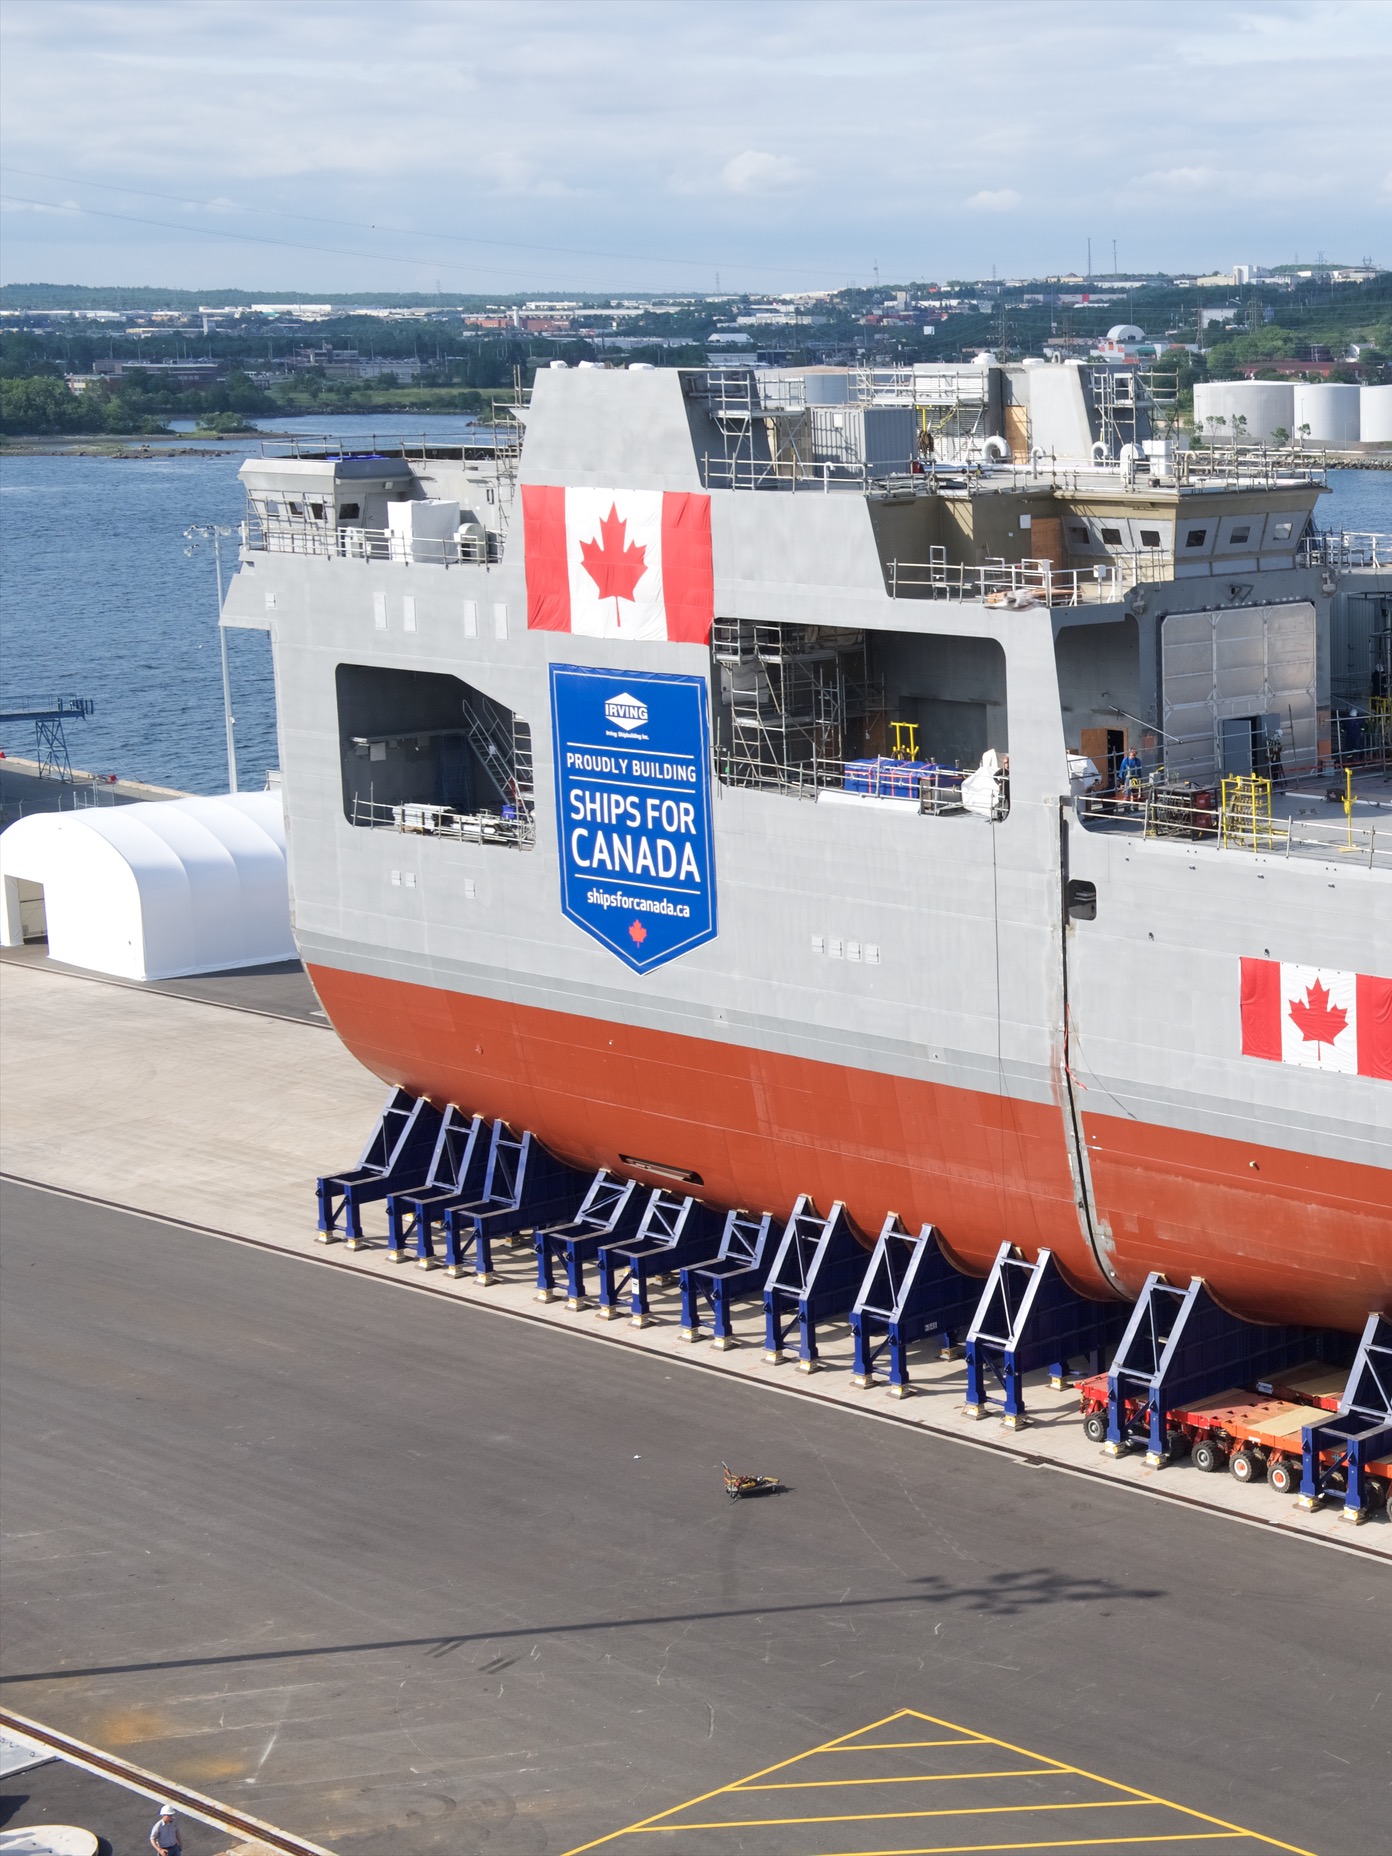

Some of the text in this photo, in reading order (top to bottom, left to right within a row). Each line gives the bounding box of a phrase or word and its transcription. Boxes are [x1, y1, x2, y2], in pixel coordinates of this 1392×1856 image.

[605, 703, 648, 720] IRVING
[566, 752, 696, 782] PROUDLY BUILDING
[569, 789, 697, 834] SHIPS FOR
[571, 828, 701, 882] CANADA
[587, 889, 690, 917] shipsforcanada.ca
